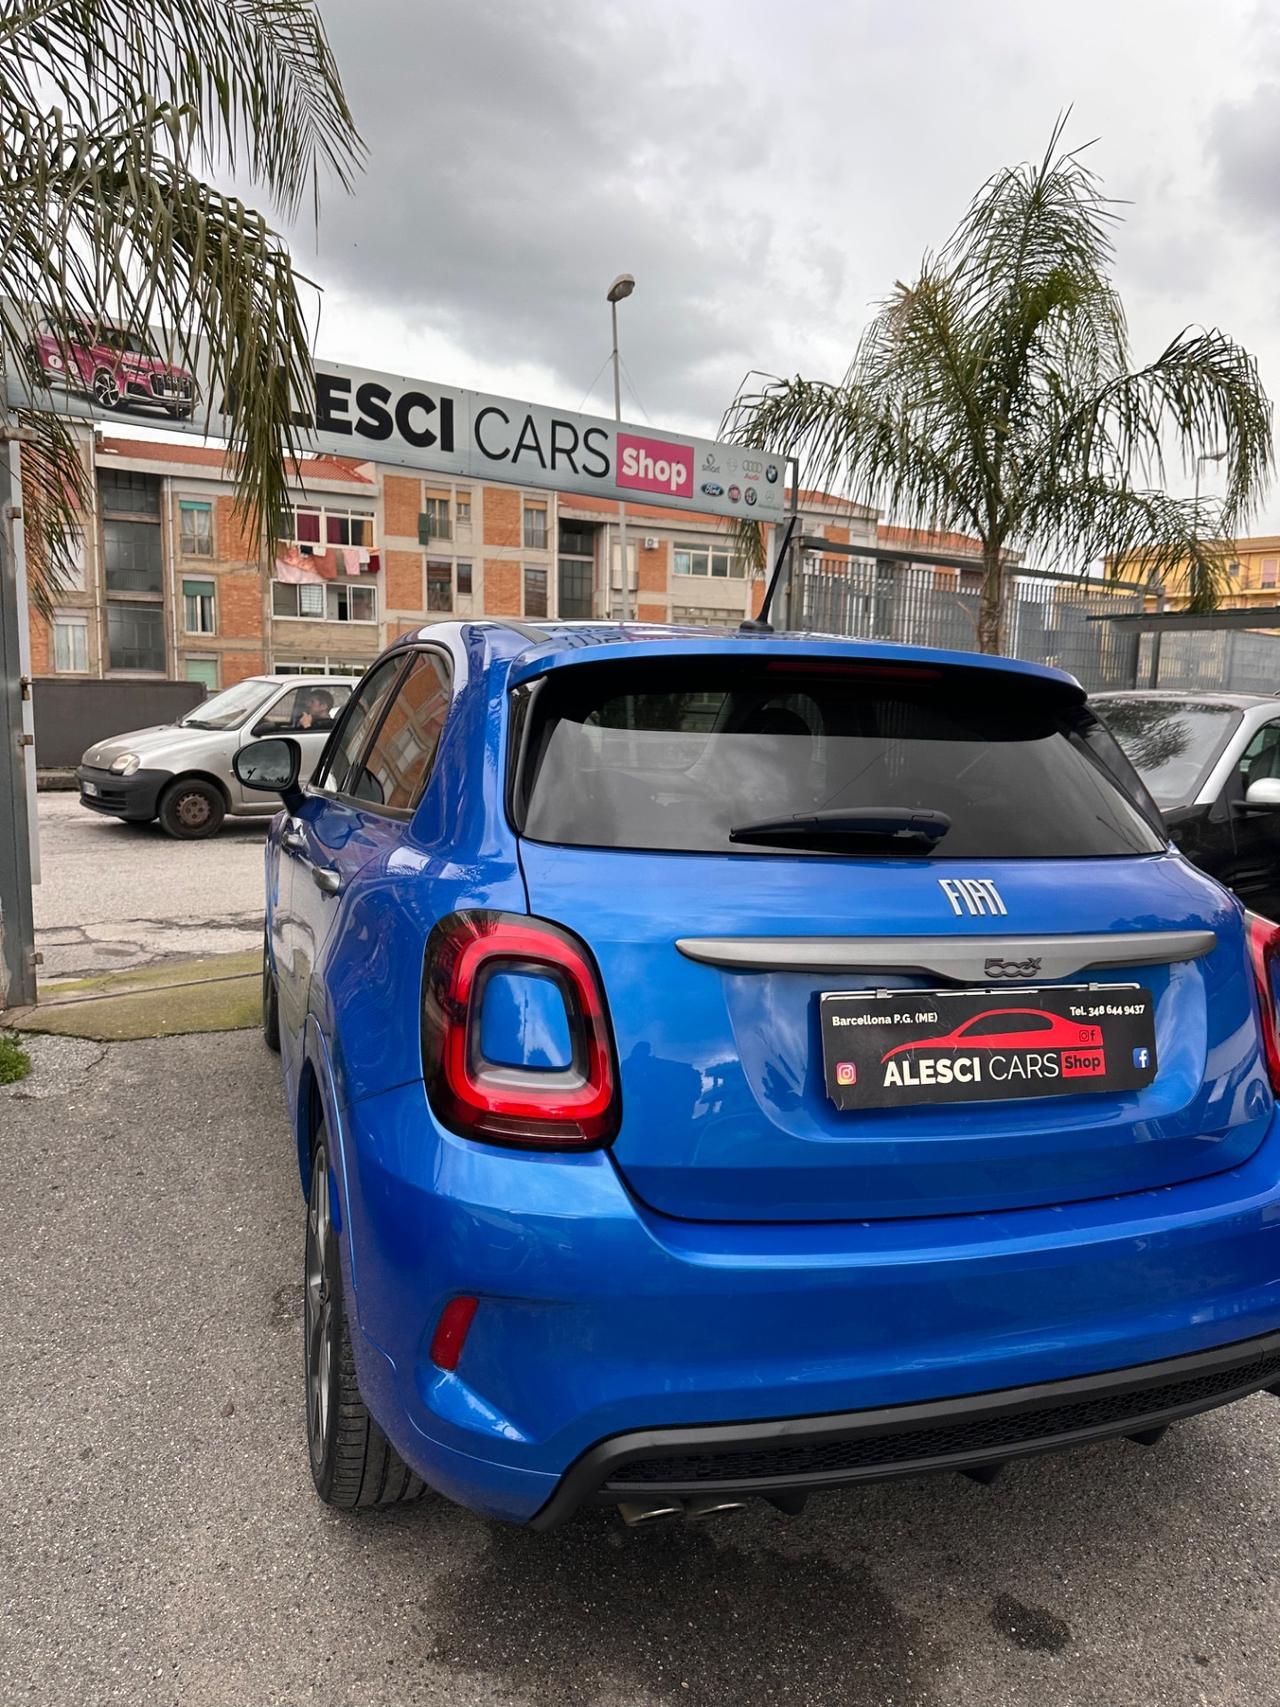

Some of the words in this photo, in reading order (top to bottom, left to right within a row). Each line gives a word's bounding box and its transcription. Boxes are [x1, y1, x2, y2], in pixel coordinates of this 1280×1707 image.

[219, 364, 454, 453] ESCI
[474, 406, 611, 478] CARS
[622, 447, 687, 491] Shop
[937, 879, 1008, 917] FIAT
[832, 1015, 892, 1026] Barcellona
[893, 1014, 914, 1024] P.G.
[915, 1012, 938, 1023] (ME)
[1069, 1006, 1087, 1016] Tel.
[1088, 1005, 1105, 1017] 348
[1106, 1005, 1123, 1015] 644
[1124, 1004, 1145, 1015] 9437
[883, 1057, 981, 1087] ALESCI
[988, 1053, 1059, 1081] CARS
[1064, 1055, 1101, 1071] Shop
